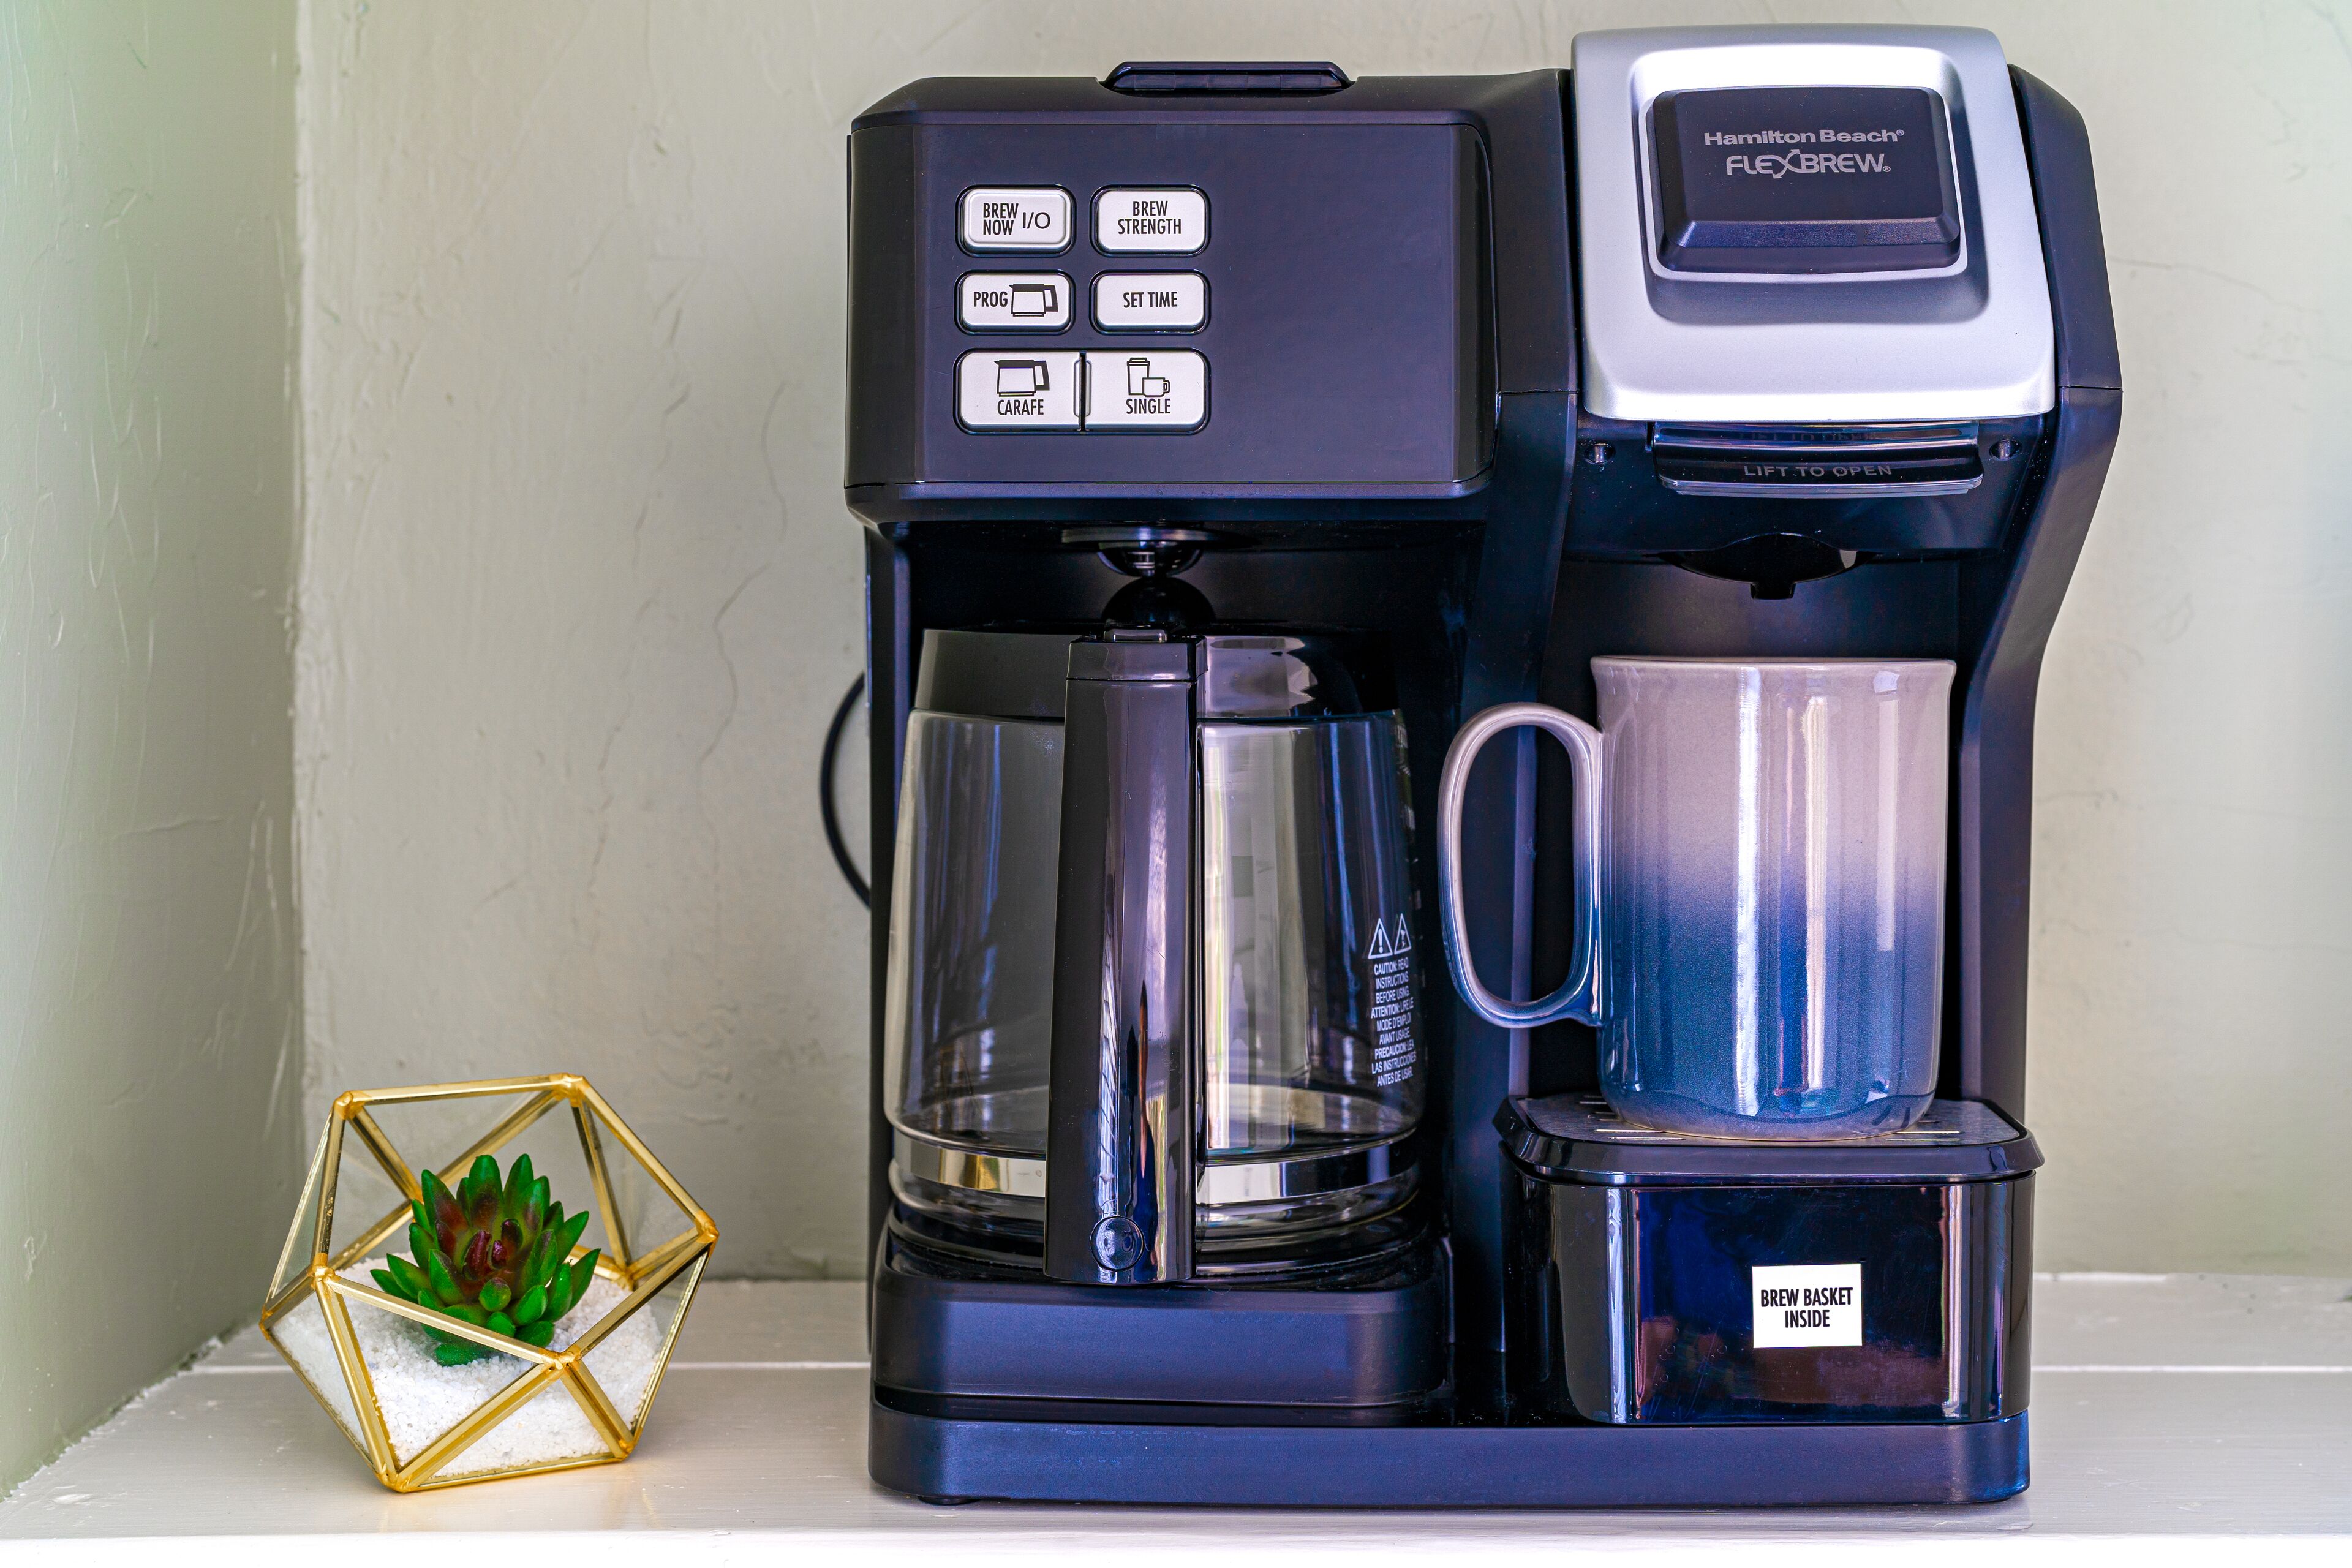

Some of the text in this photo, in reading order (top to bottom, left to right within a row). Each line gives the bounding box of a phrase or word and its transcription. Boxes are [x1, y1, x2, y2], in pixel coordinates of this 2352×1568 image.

[1704, 130, 1816, 145] Hamilton
[983, 203, 1019, 219] BREW
[1133, 200, 1168, 216] BREW
[983, 219, 1014, 236] NOW
[1022, 212, 1051, 230] I/O
[1118, 218, 1182, 235] STRENGTH
[973, 291, 1008, 307] PROG
[1123, 291, 1178, 308] SET TIME
[997, 399, 1044, 416] CARAFE
[1126, 398, 1171, 415] SINGLE
[1744, 464, 1893, 477] LIFT TO OPEN
[1374, 957, 1409, 976] CAUTION: READ
[1376, 971, 1409, 990] INSTRUCTIONS
[1376, 990, 1396, 1004] BEFORE
[1409, 997, 1414, 1009] LE
[1376, 1018, 1392, 1032] MODE
[1379, 1031, 1395, 1045] AVANT
[1372, 1061, 1382, 1074] LAS
[1377, 1072, 1394, 1087] ANTES
[1395, 1070, 1401, 1082] DE
[1760, 1287, 1853, 1307] BREW BASKET
[1785, 1309, 1830, 1328] INSIDE
